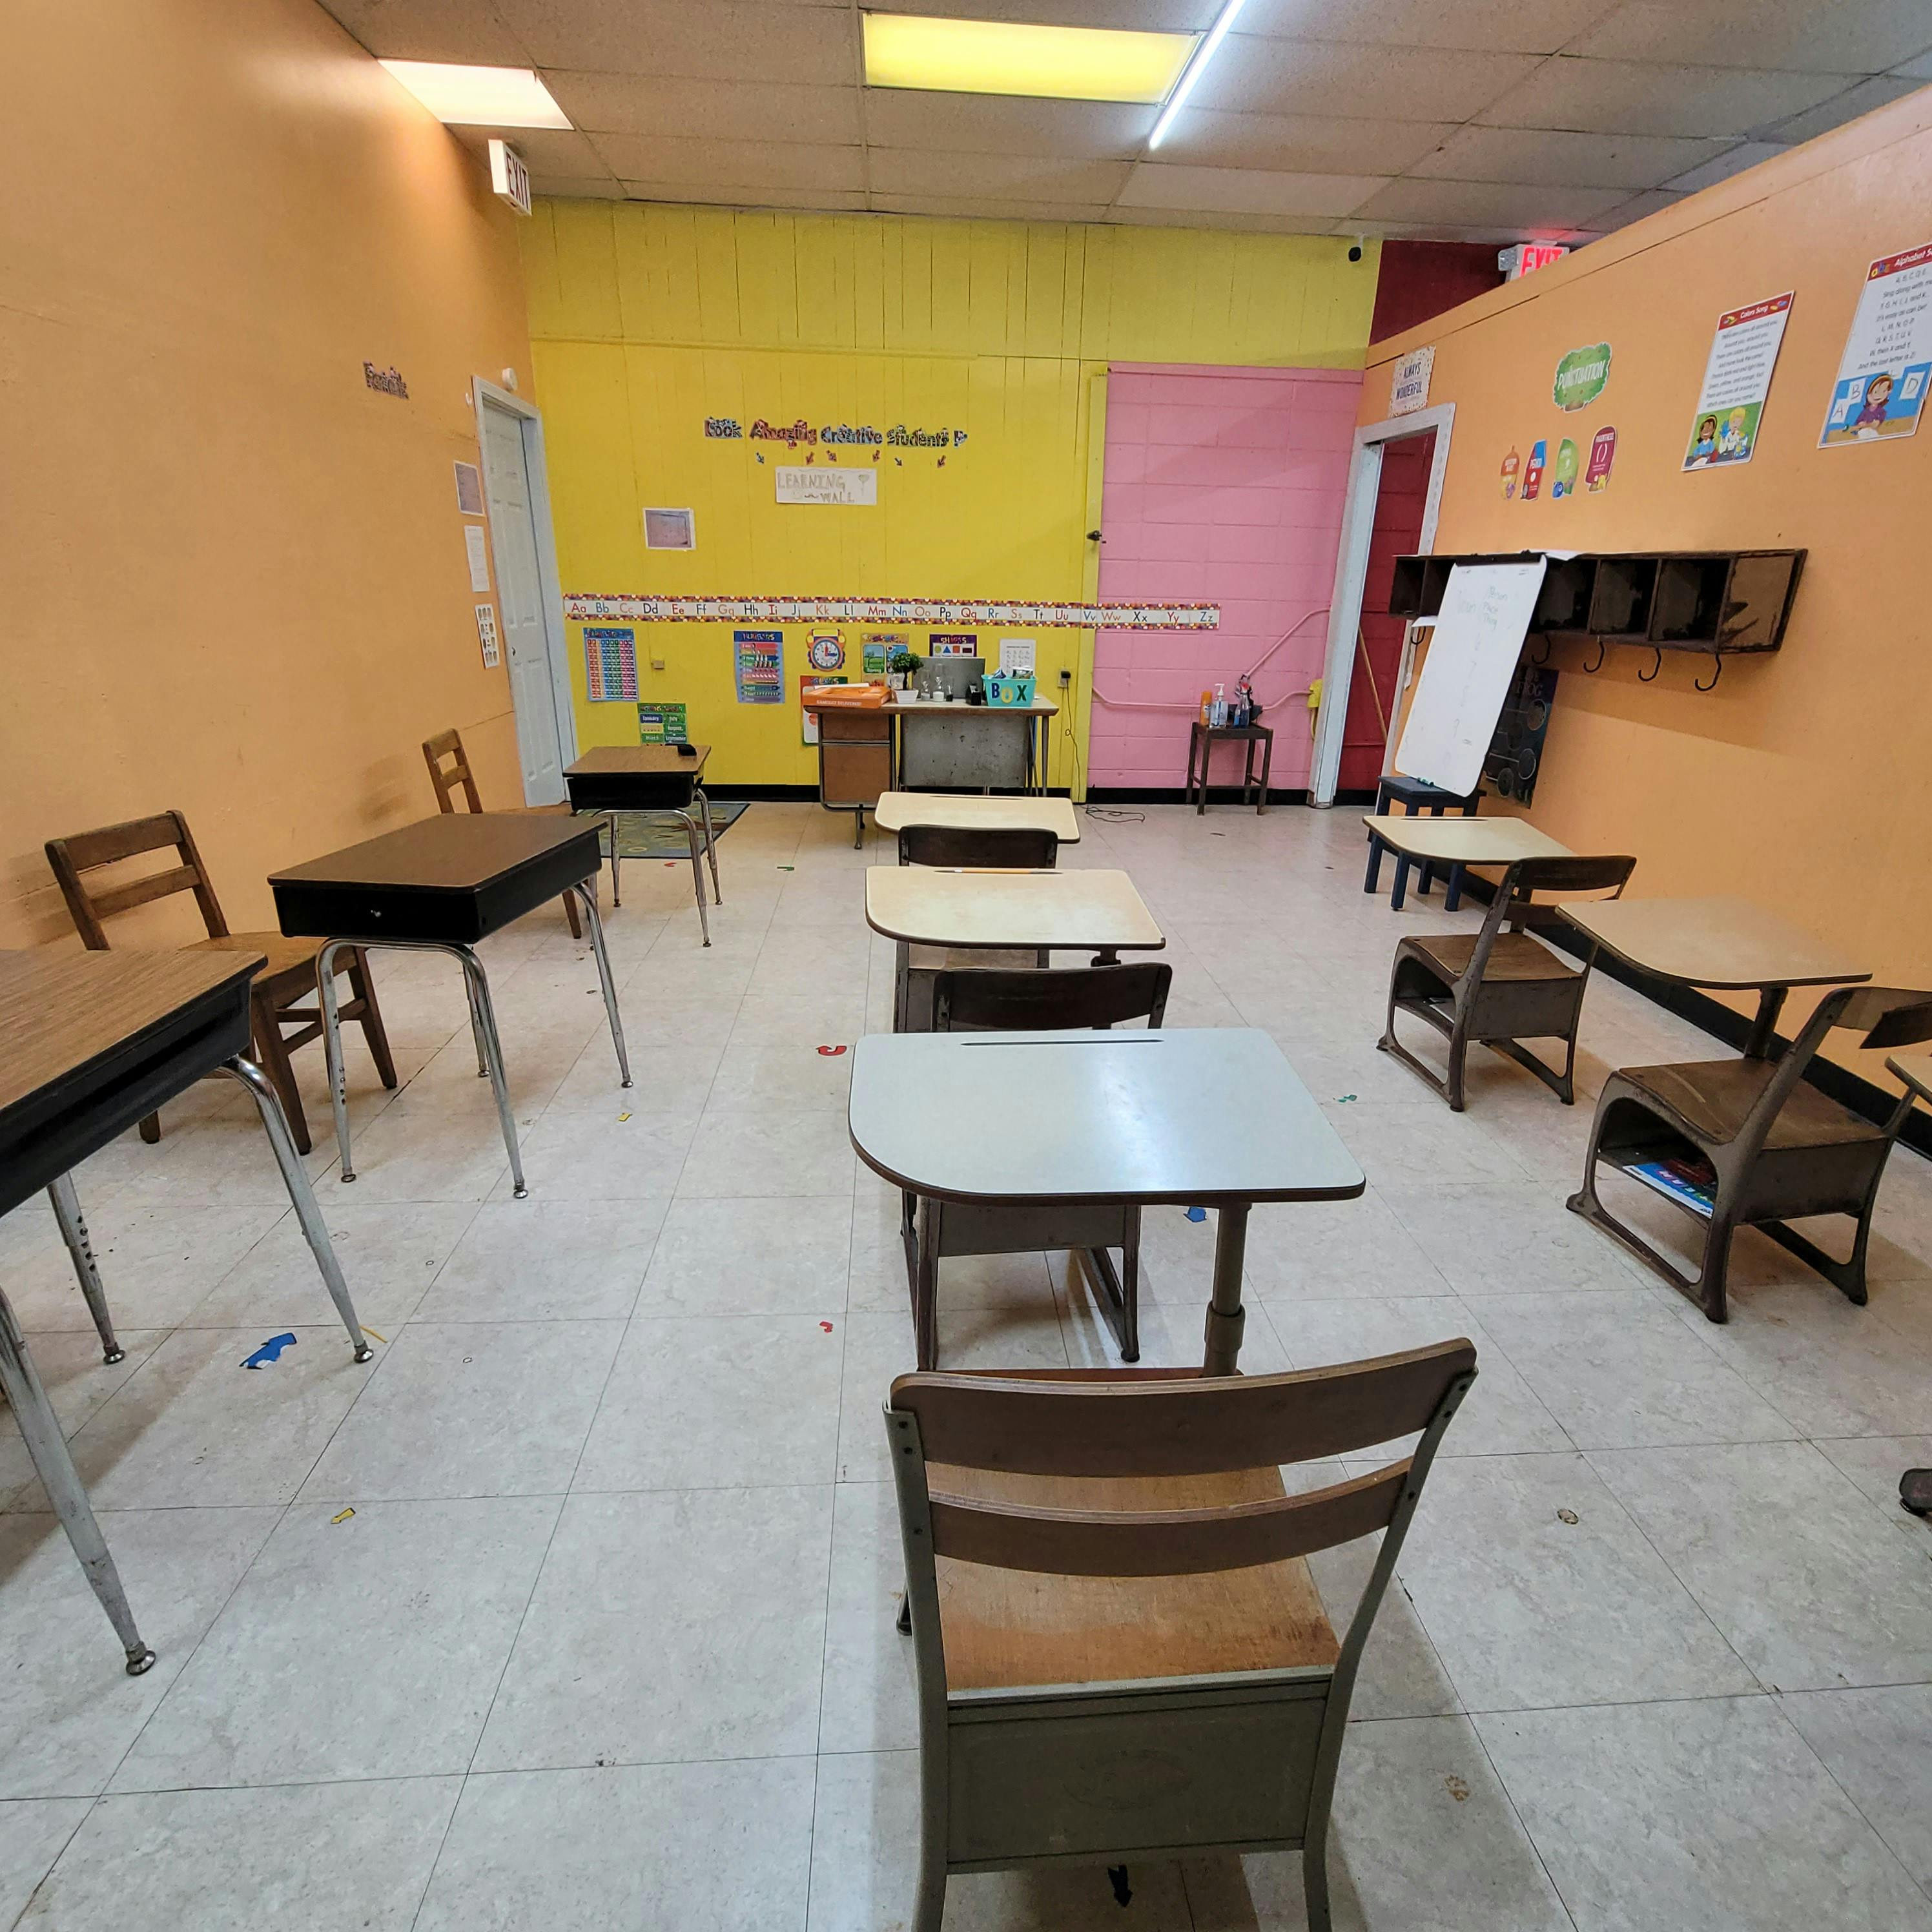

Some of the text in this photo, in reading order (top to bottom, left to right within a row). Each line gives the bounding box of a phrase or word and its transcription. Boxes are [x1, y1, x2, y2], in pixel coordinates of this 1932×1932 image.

[506, 151, 528, 210] EXIT
[1755, 305, 1769, 314] Song
[1557, 360, 1606, 390] PUNCTUATION
[1396, 381, 1422, 400] WONDERFUL
[1851, 384, 1860, 400] B
[1906, 378, 1919, 394] D
[1833, 405, 1843, 418] A
[704, 416, 743, 438] Look
[749, 419, 817, 449] Amazing
[821, 424, 883, 446] Creative
[777, 473, 846, 492] LEARNING
[820, 492, 855, 503] WALL
[571, 602, 1213, 625] Aa Bb Cc Dd Ee Ff Gg Hh Ii Jj Kk Ll Mm Nn Oo Pp Qq Rr Ss Tt Uu Vv Ww Xx Yy Zz
[991, 683, 1027, 703] BOX
